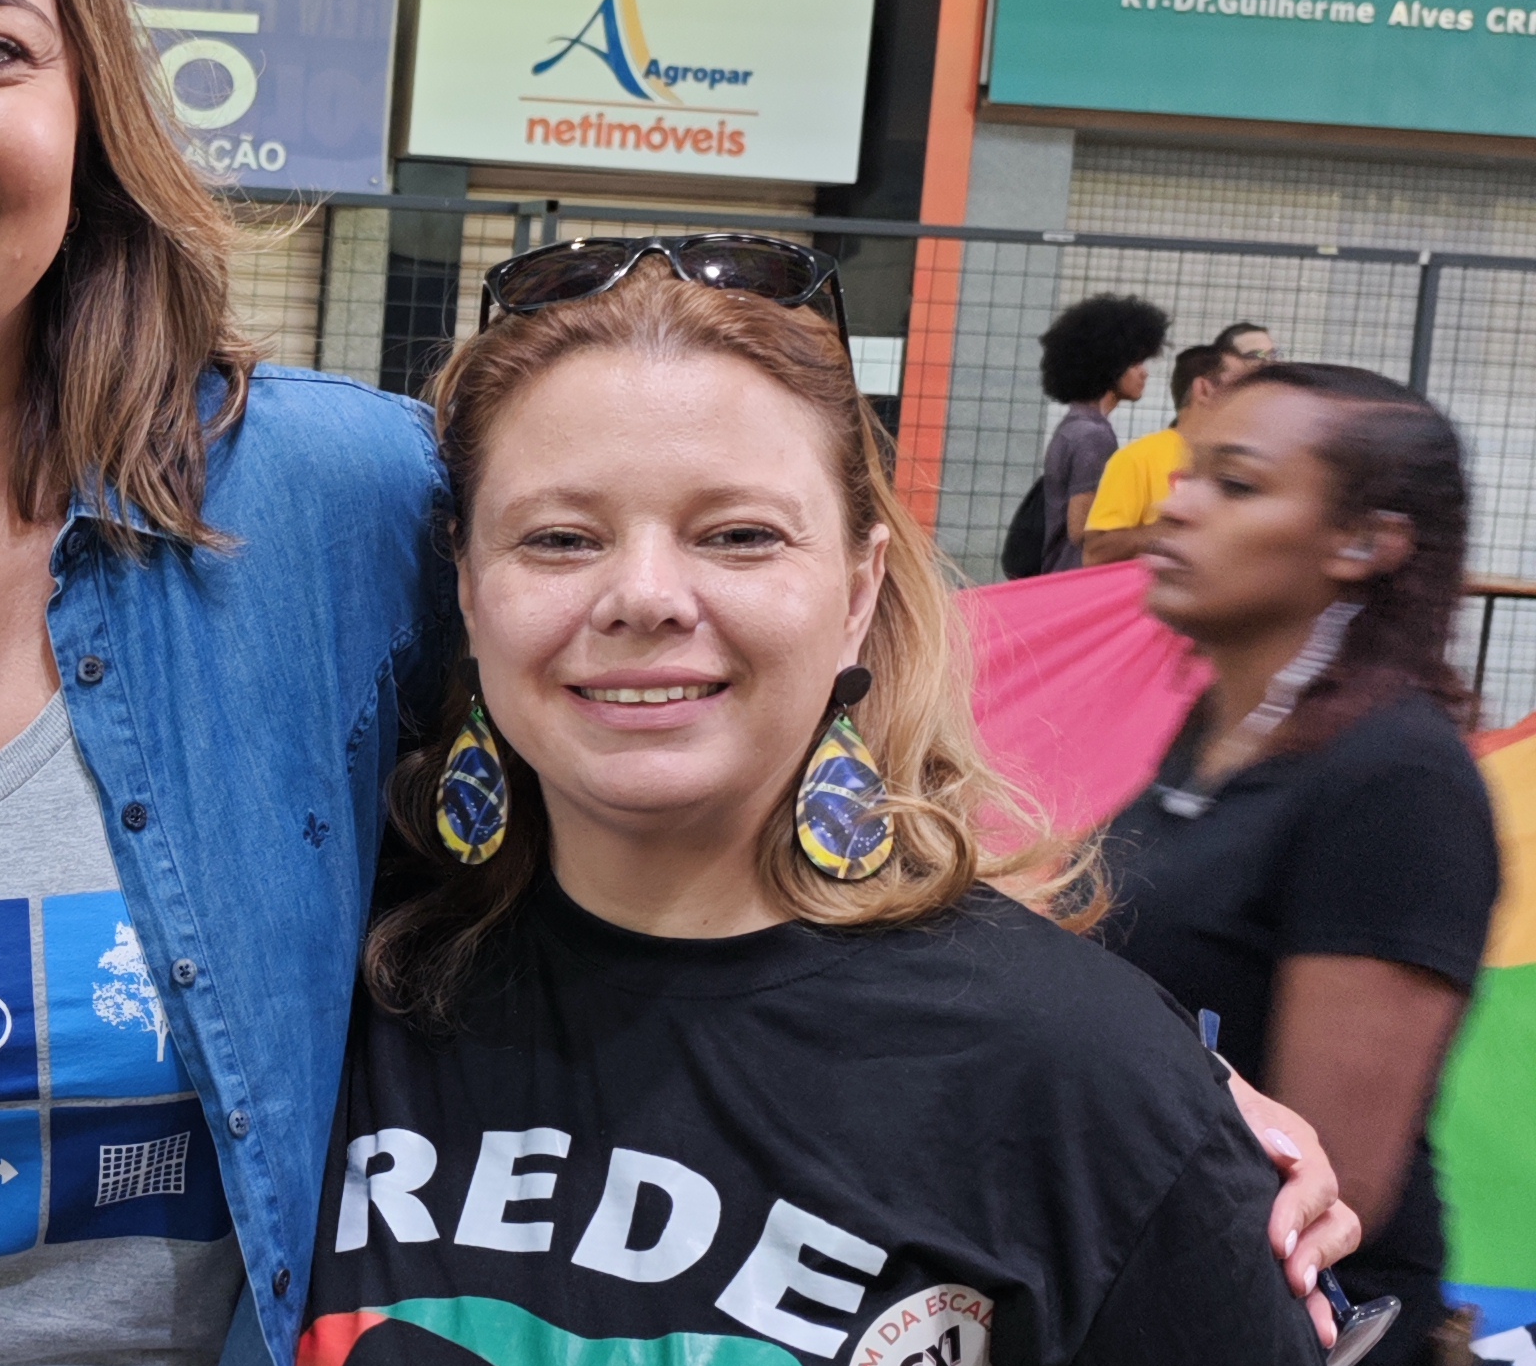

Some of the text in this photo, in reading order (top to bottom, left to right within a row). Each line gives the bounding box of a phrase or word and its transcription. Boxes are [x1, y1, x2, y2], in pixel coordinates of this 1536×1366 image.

[643, 56, 754, 92] Agropar
[524, 108, 748, 159] netimóveis
[335, 1126, 888, 1359] REDE
[877, 1308, 922, 1346] DA
[925, 1291, 995, 1334] ESCAL
